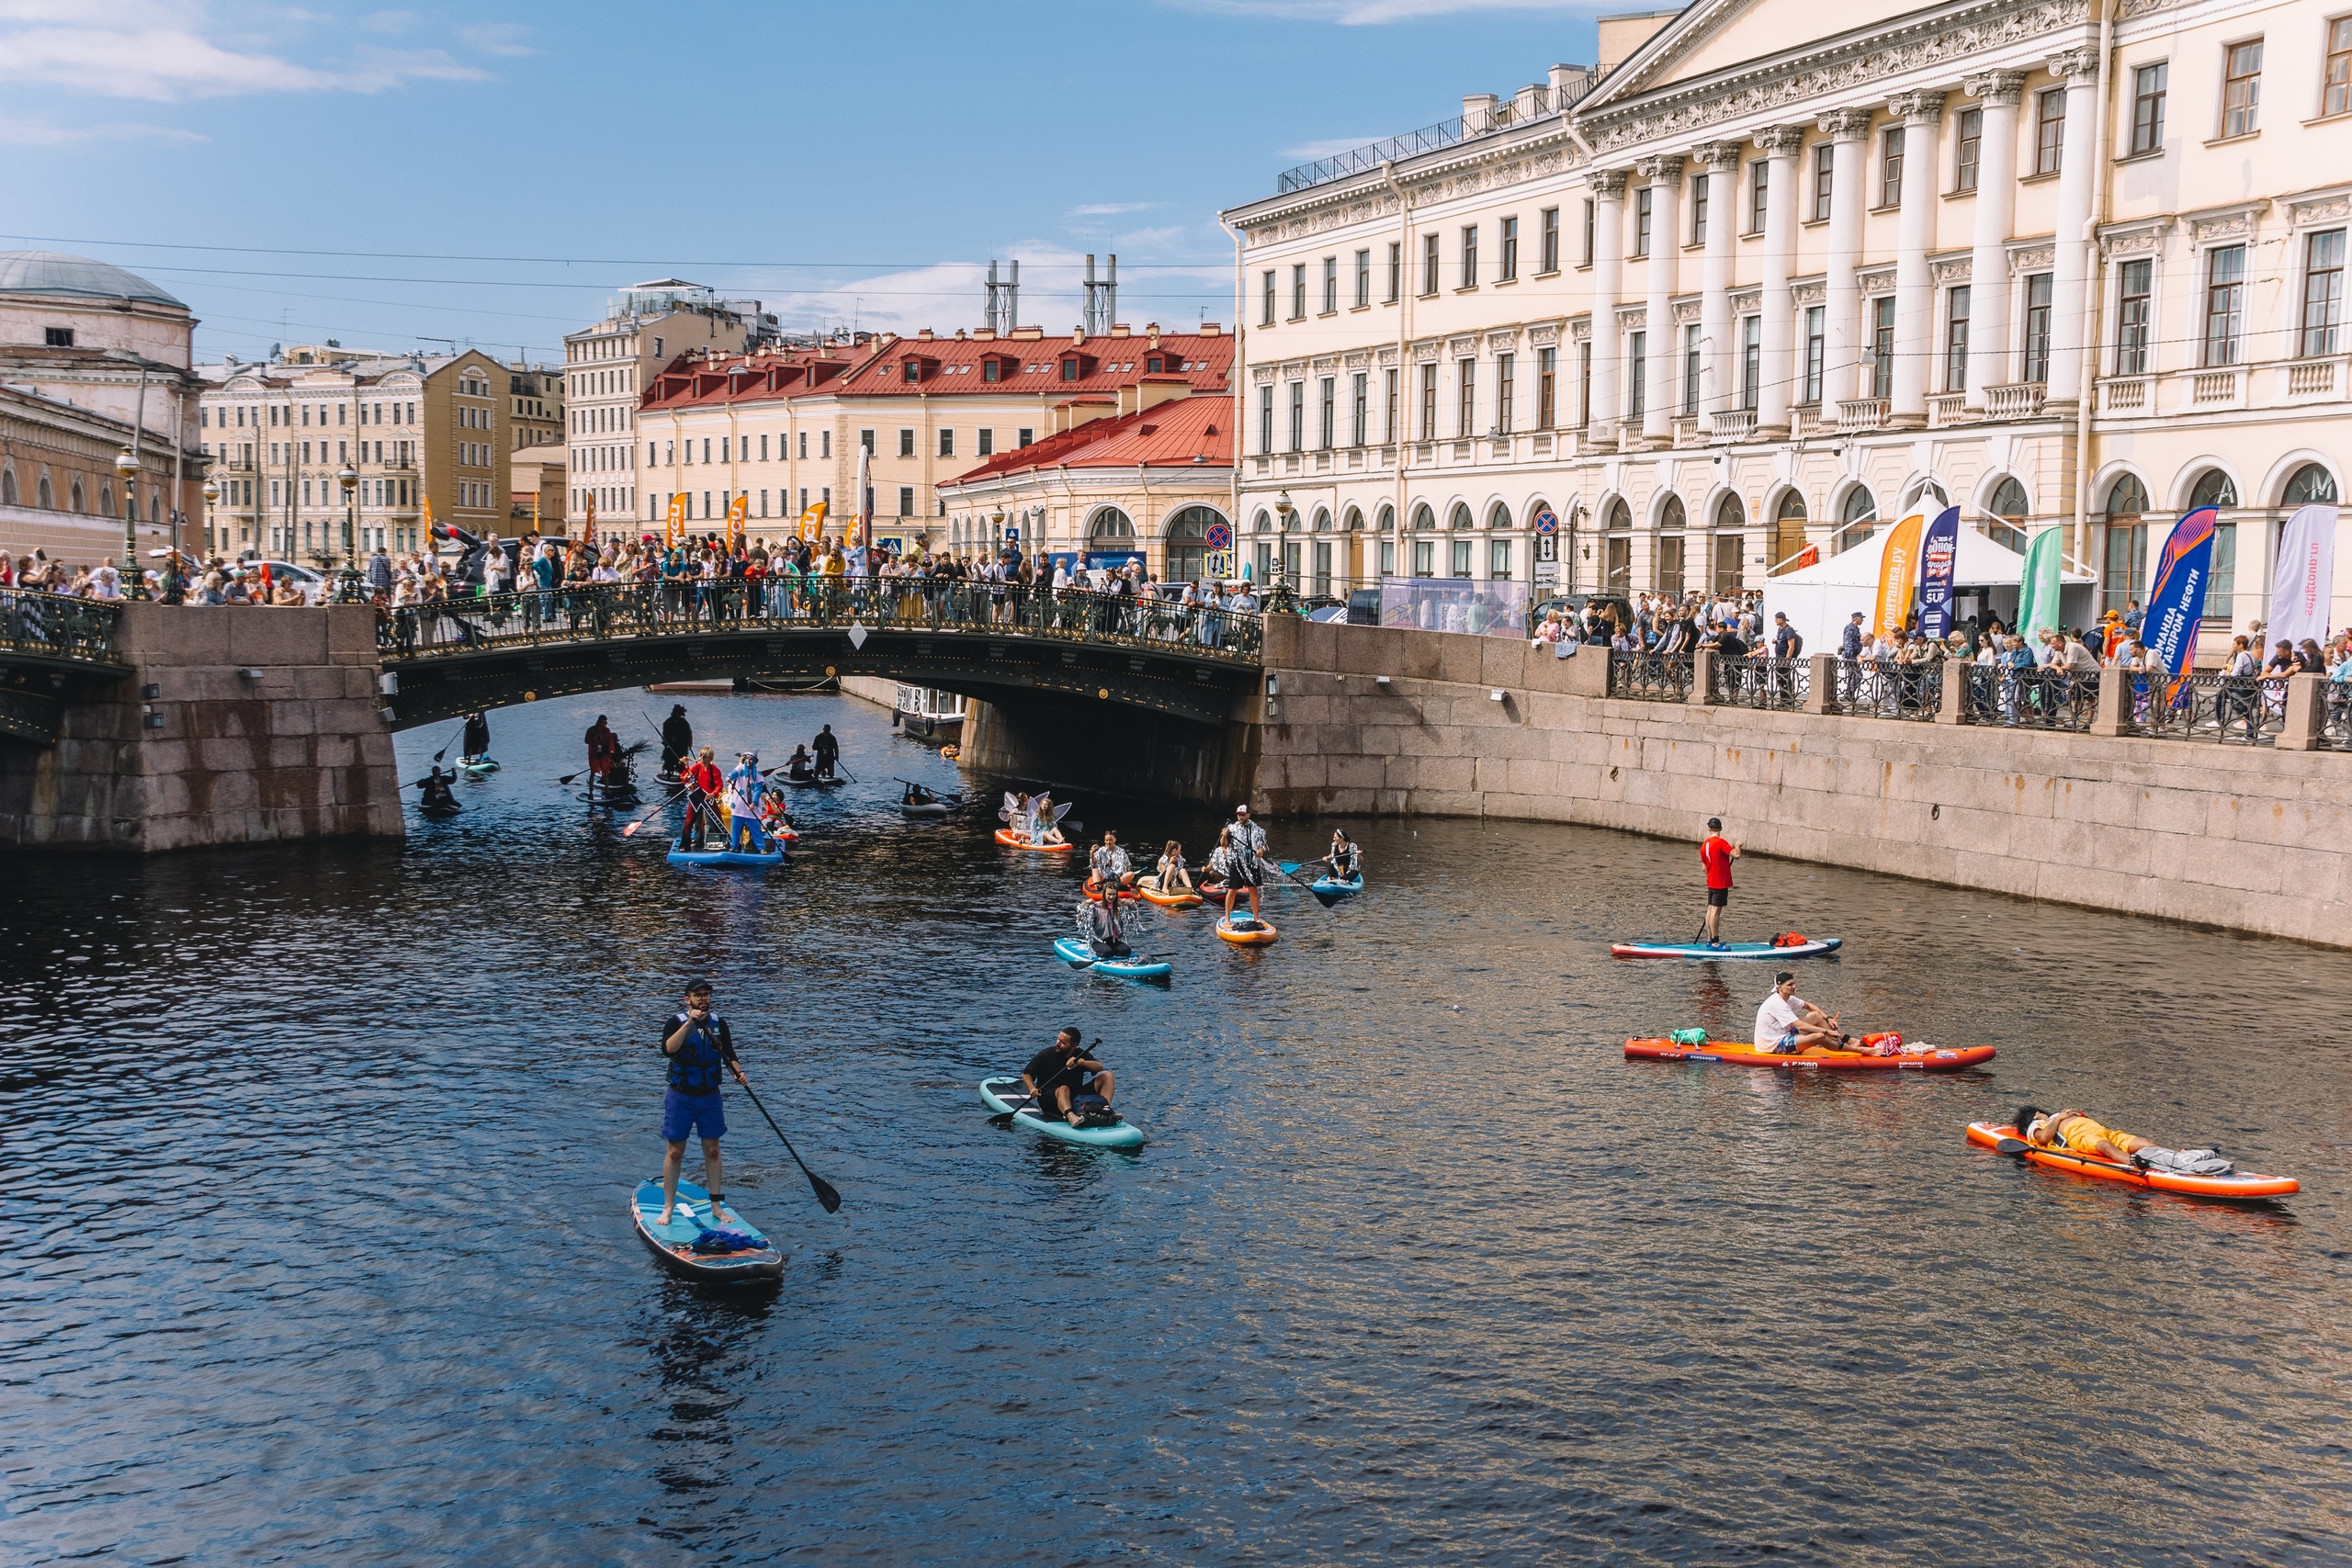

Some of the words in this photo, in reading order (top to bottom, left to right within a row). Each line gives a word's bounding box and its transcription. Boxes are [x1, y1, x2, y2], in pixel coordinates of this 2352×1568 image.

[1883, 547, 1907, 630] фонтанка.ру
[1926, 592, 1945, 604] SUP
[2163, 613, 2186, 670] ГАЗПРОМ
[2179, 568, 2200, 612] НЕФТИ
[2154, 607, 2177, 659] ОМАНДА
